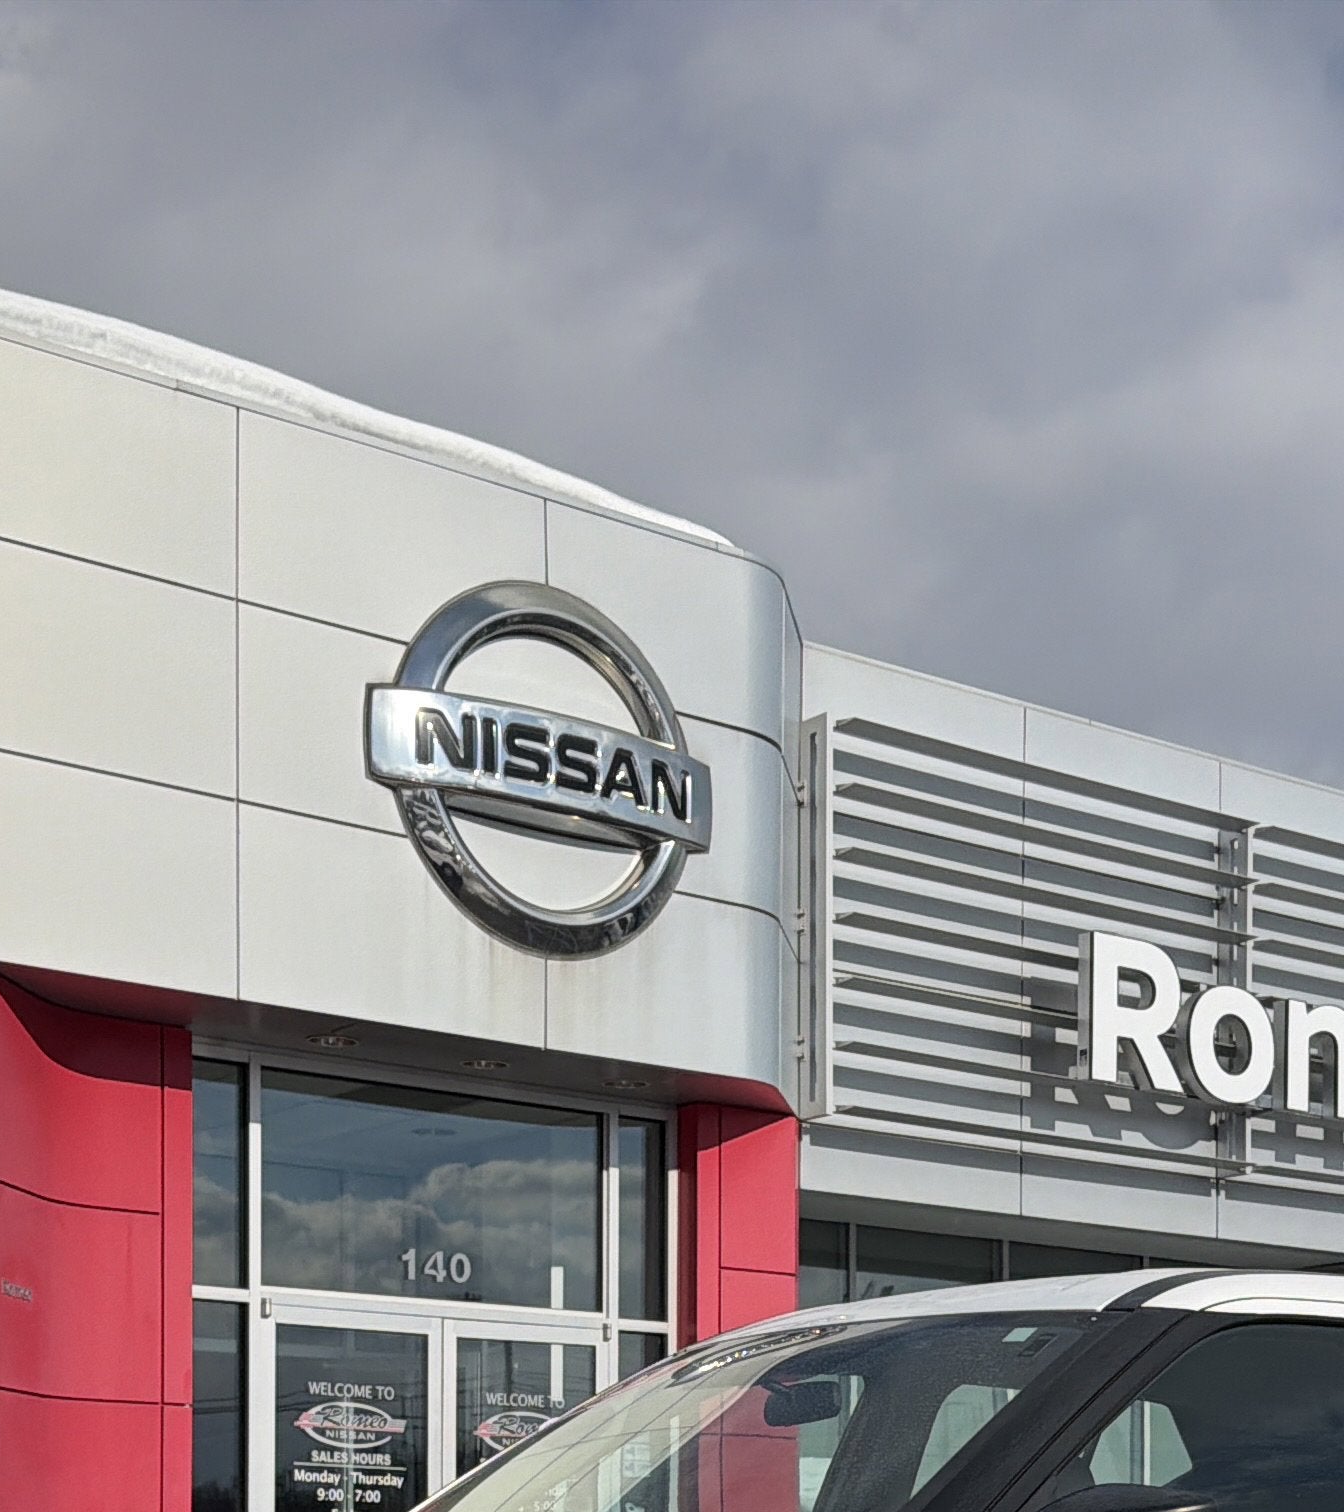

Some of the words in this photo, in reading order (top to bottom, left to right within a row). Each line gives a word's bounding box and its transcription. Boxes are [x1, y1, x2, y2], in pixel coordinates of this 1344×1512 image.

[414, 706, 692, 824] NISSAN
[401, 1248, 472, 1283] 140
[308, 1381, 372, 1399] WELCOME
[375, 1385, 395, 1400] TO
[486, 1392, 544, 1408] WELCOME
[548, 1395, 565, 1409] TO
[315, 1405, 388, 1429] Romeo
[325, 1430, 376, 1441] NISSAN
[311, 1450, 348, 1463] SALES
[351, 1453, 391, 1465] HOURS
[294, 1469, 341, 1485] Monday
[350, 1471, 405, 1489] Thursday
[317, 1488, 344, 1501] 9:00
[355, 1490, 381, 1503] 7:00
